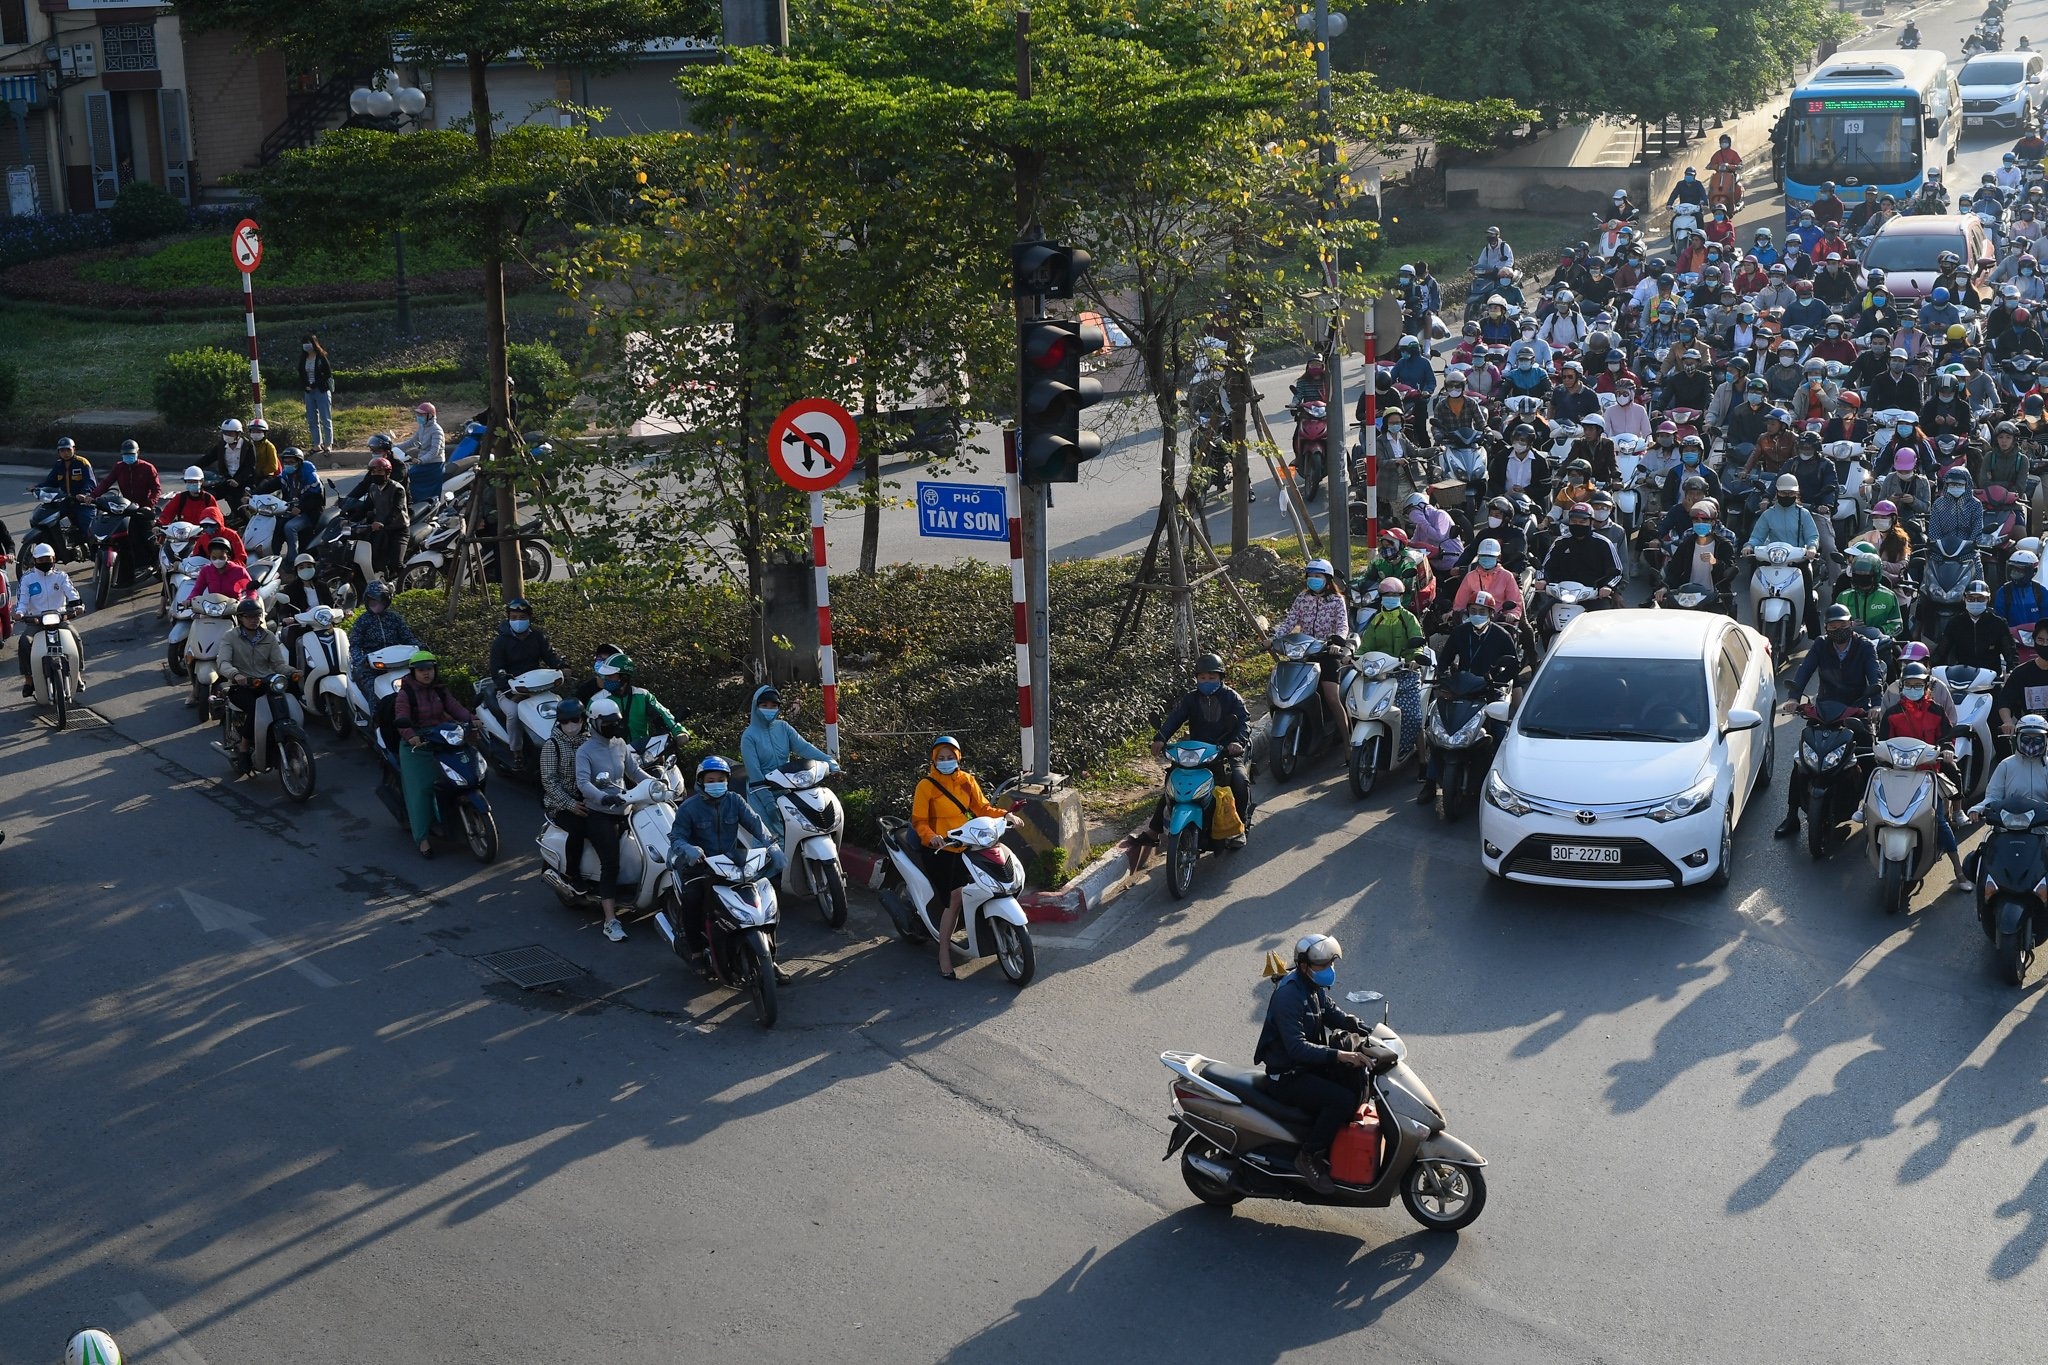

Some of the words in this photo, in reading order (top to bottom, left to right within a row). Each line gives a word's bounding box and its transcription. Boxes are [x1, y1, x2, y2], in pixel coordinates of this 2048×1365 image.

[1848, 123, 1860, 132] 19
[953, 491, 981, 504] PHỐ
[927, 507, 958, 528] TÂY
[963, 512, 1000, 531] SƠN
[1553, 847, 1619, 862] 30F-227.80
